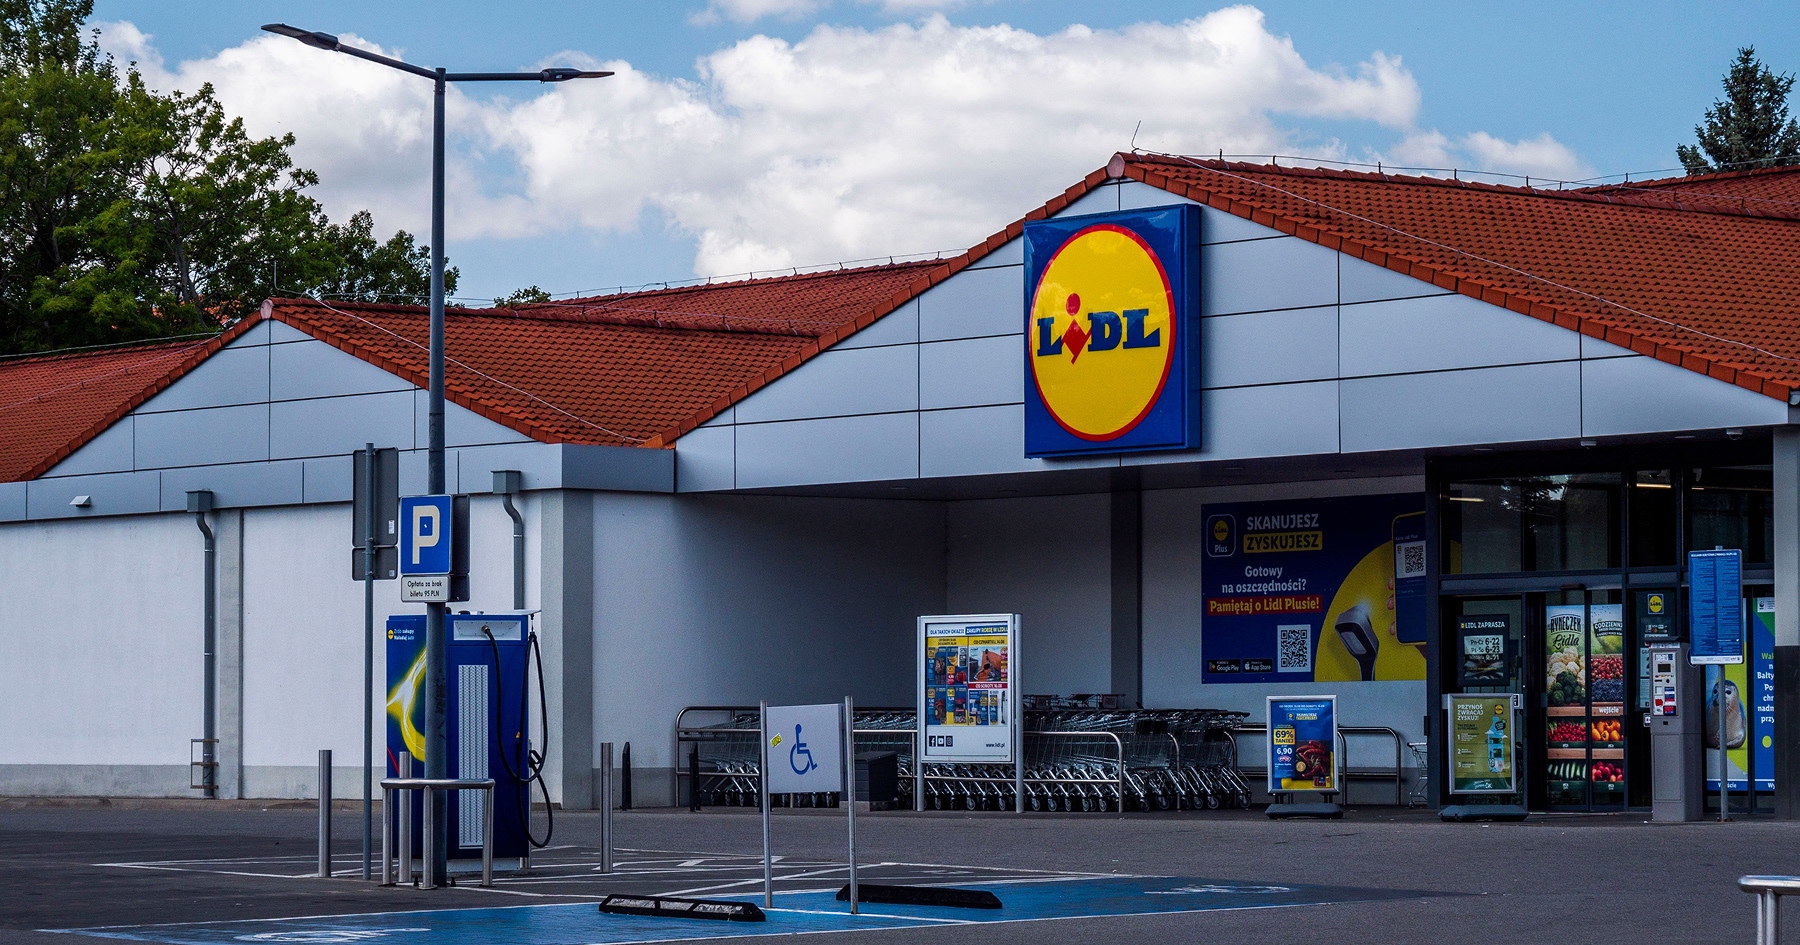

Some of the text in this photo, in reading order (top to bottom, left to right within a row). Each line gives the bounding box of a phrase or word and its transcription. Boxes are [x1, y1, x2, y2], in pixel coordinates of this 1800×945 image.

[1247, 513, 1319, 531] SKANUJESZ
[412, 505, 440, 565] P
[1247, 534, 1319, 551] ZYSKUJESZ
[1214, 544, 1228, 553] Plus
[1245, 565, 1283, 579] Gotowy
[1221, 578, 1307, 595] na oszczędności?
[1209, 597, 1320, 614] Pamiętaj o Lidl Plusie!
[1477, 621, 1506, 629] ZAPRASZA
[1485, 637, 1500, 645] 6-22
[1485, 645, 1500, 654] 6-23
[1216, 664, 1230, 672] Google
[1598, 706, 1619, 715] wejście
[1275, 730, 1294, 739] 69%
[1276, 747, 1293, 755] 6,90
